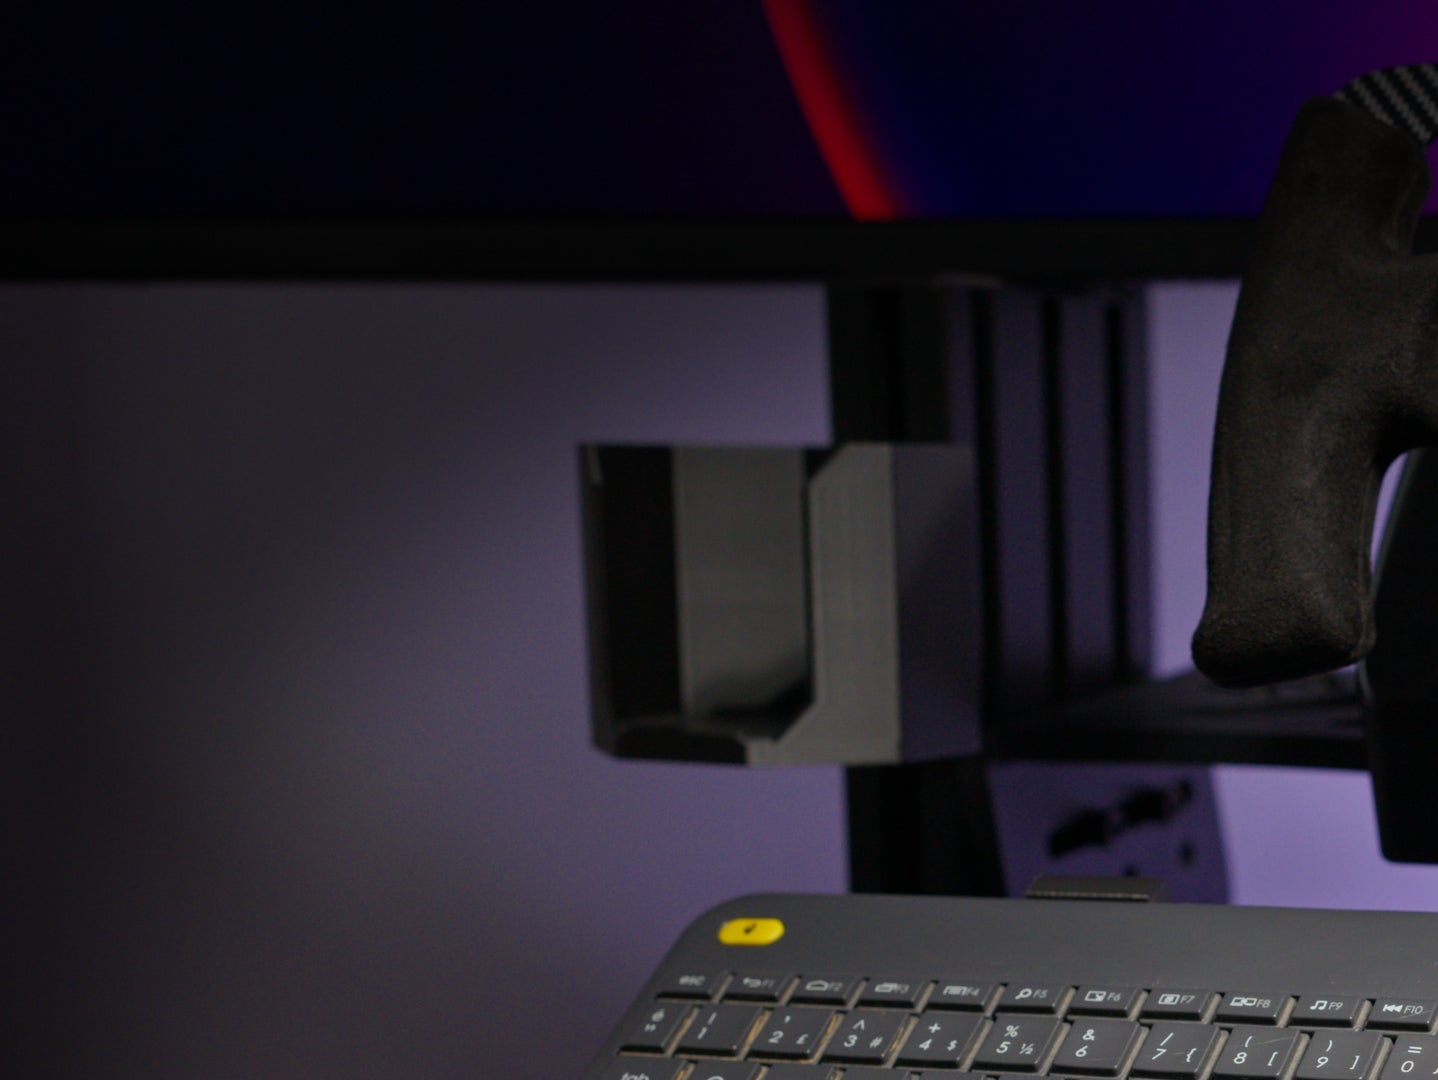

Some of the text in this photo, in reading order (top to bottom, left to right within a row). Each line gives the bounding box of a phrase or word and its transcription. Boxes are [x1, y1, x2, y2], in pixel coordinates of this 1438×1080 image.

[966, 986, 980, 997] F4
[1033, 989, 1047, 998] F5
[1107, 993, 1121, 1001] F6
[1180, 995, 1195, 1003] F7
[1257, 999, 1271, 1008] F8
[1328, 1002, 1343, 1010] F9
[1404, 1006, 1423, 1014] F10
[1005, 1025, 1019, 1037] %
[1083, 1029, 1095, 1040] &
[769, 1031, 783, 1043] 2
[844, 1035, 857, 1047] 3
[870, 1037, 882, 1047] #
[920, 1039, 932, 1050] 4
[947, 1040, 957, 1051] $
[996, 1042, 1010, 1053] 5
[1076, 1046, 1088, 1057] 6
[1152, 1048, 1166, 1059] 7
[1186, 1048, 1196, 1062] {
[1234, 1052, 1247, 1064] 8
[1317, 1057, 1328, 1068] 9
